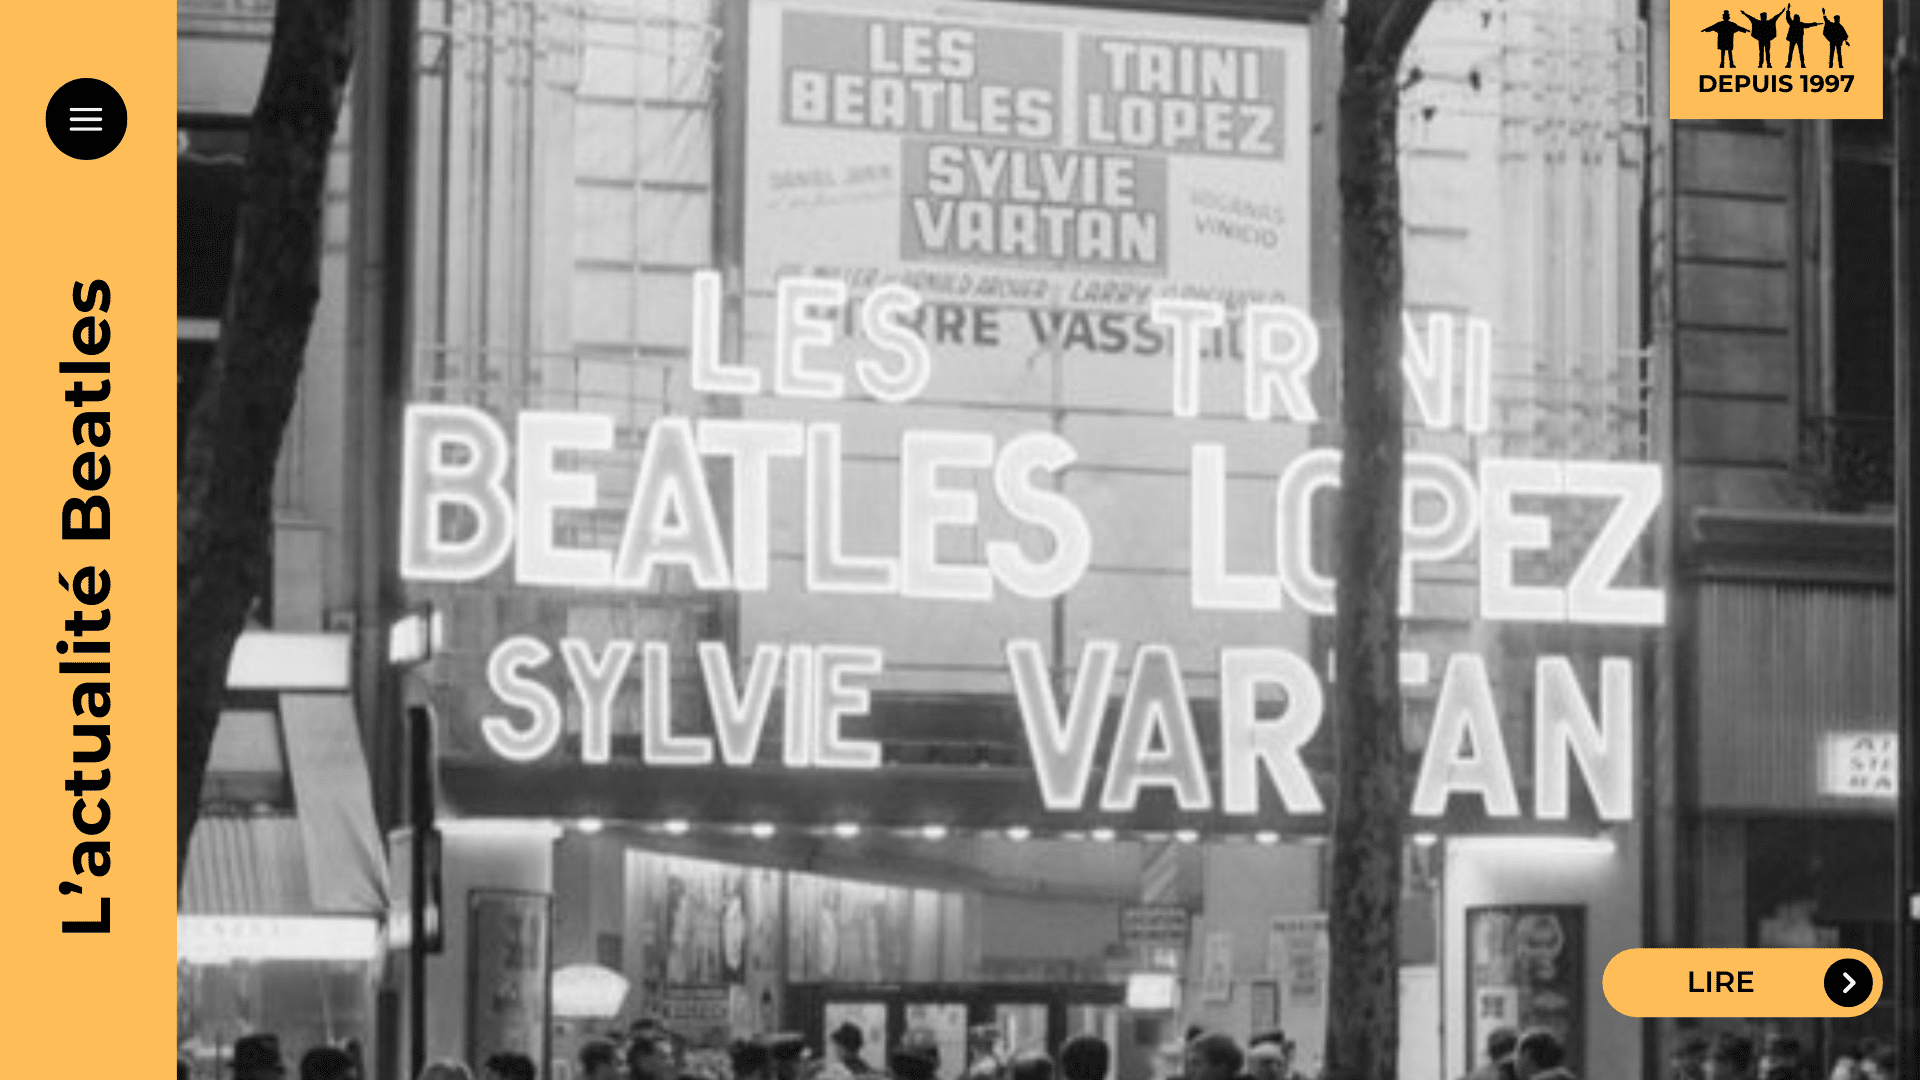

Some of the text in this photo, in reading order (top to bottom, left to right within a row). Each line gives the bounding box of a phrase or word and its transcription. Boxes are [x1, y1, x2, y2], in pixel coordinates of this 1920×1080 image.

[868, 23, 977, 78] LES
[1102, 41, 1262, 99] TRINI
[791, 70, 1054, 137] BEATLES
[1087, 94, 1275, 154] LOPEZ
[928, 145, 1135, 207] SYLVIE
[914, 200, 1157, 262] VARTAN
[692, 271, 930, 402] LES
[1151, 297, 1492, 434] TRNI
[400, 404, 1092, 600] BEATLES
[481, 635, 1634, 821] SYLVIE VARAN
